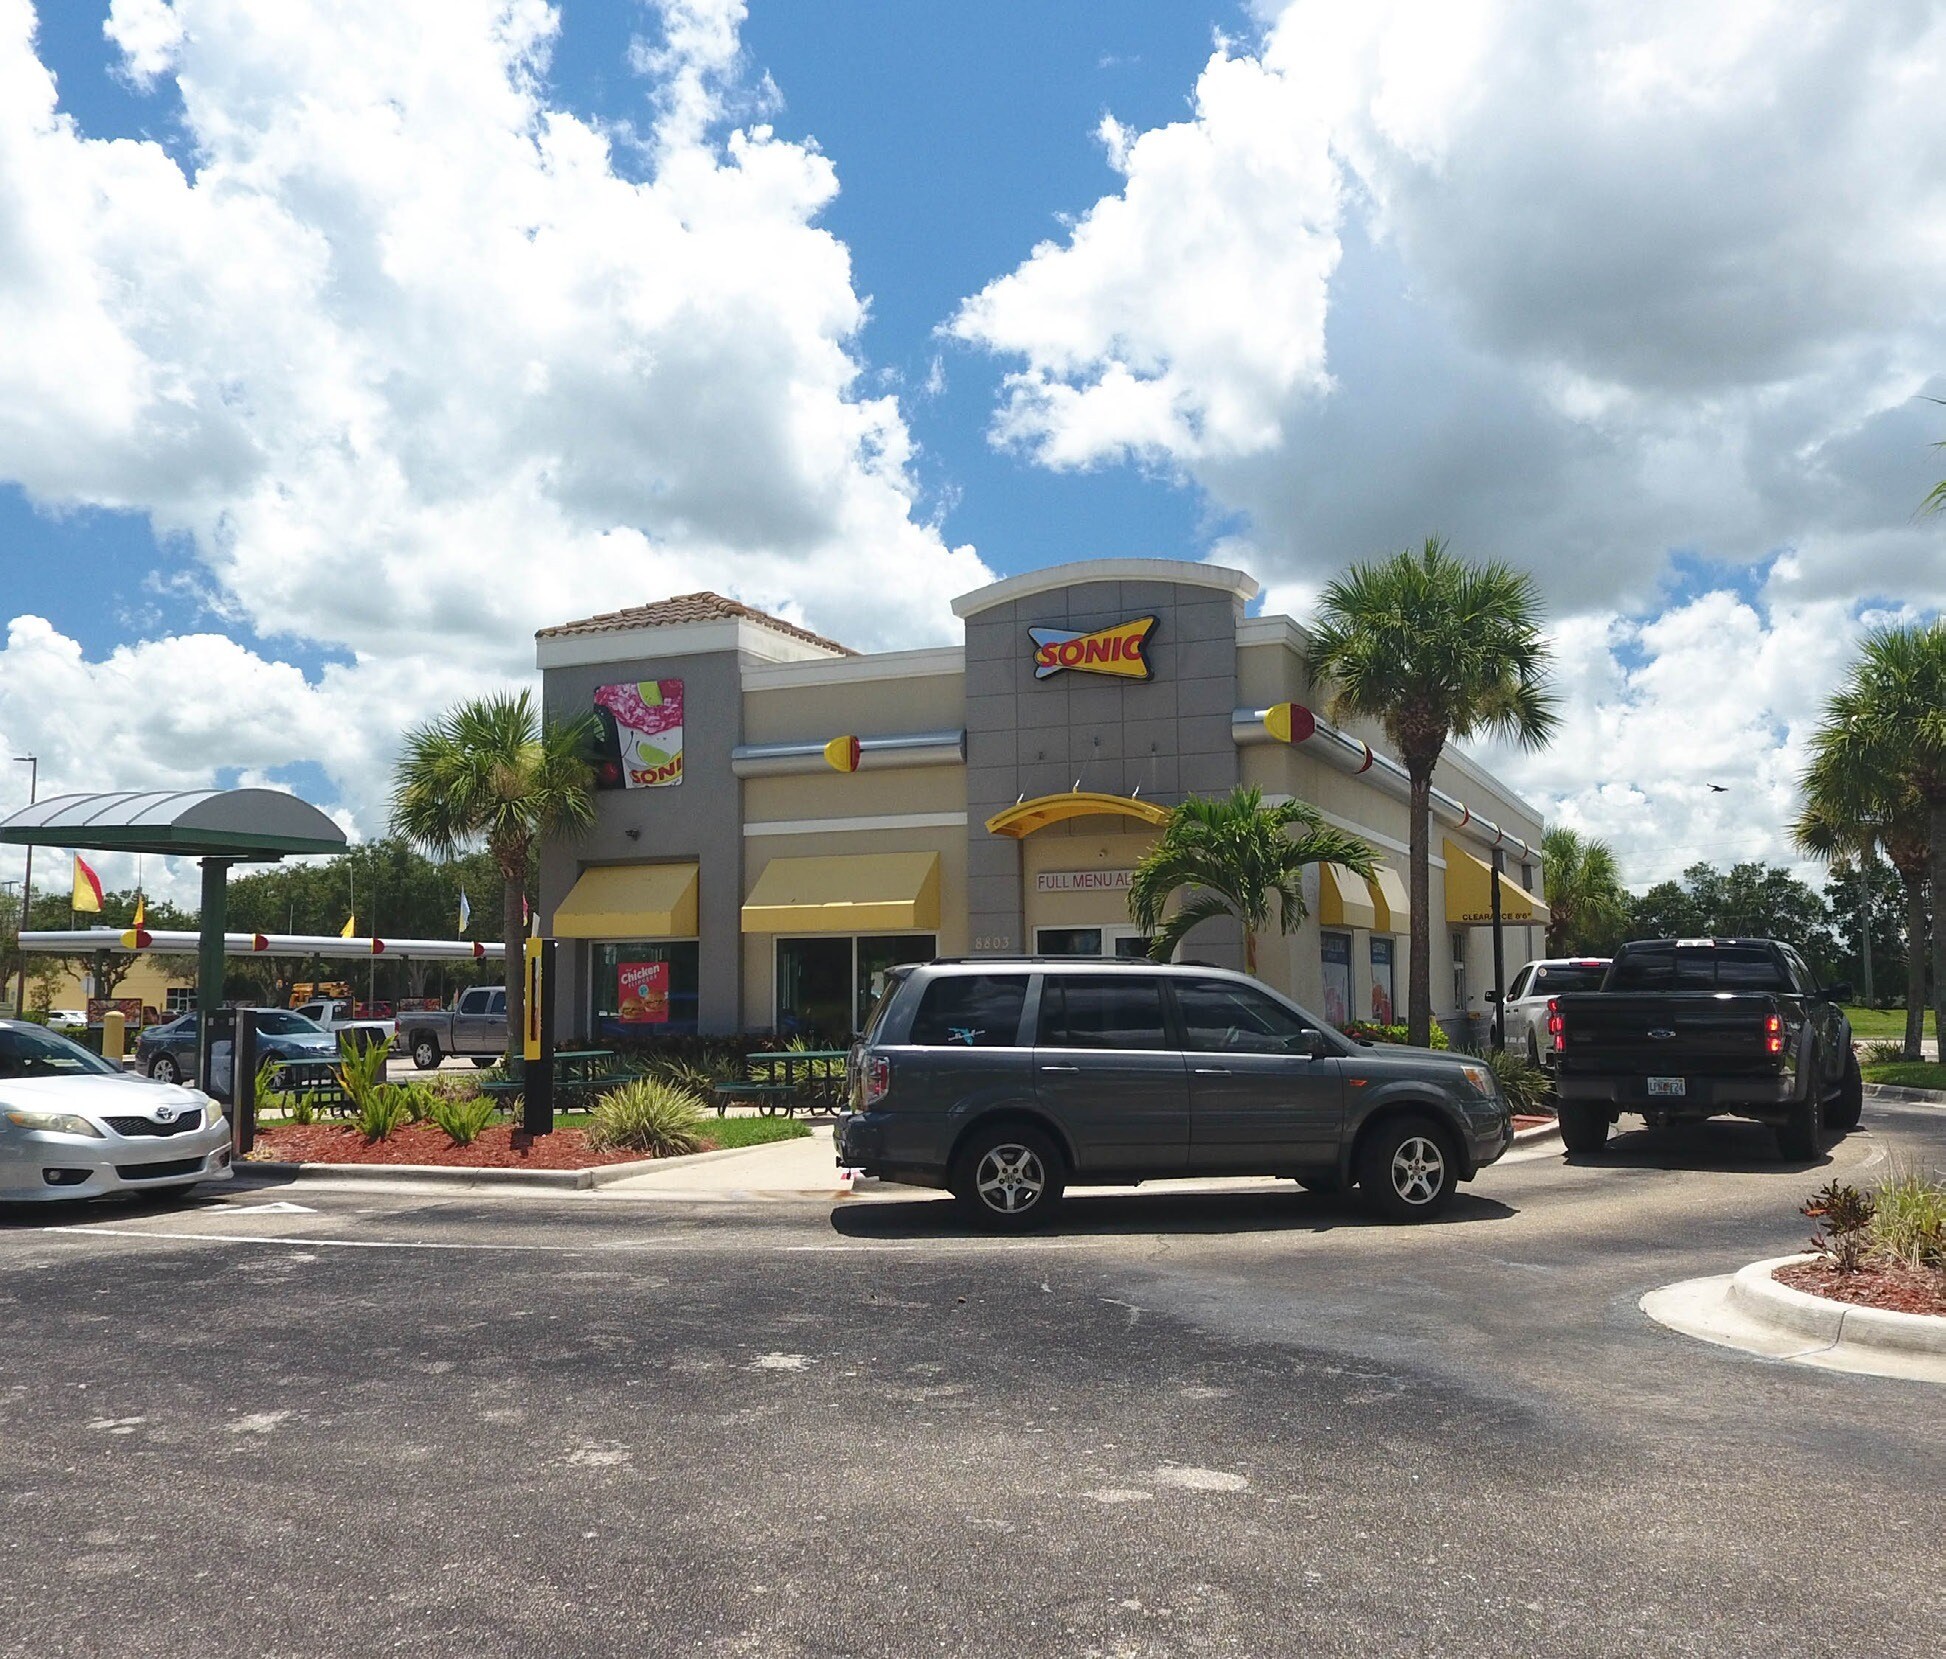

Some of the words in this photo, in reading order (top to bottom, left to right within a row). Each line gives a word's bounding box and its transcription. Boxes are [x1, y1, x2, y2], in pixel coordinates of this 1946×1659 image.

[1041, 634, 1143, 668] SONIC
[1038, 875, 1069, 889] FULL
[1073, 873, 1112, 888] MENU
[1115, 873, 1132, 886] AL
[1462, 912, 1513, 921] CLEARCE
[975, 936, 1009, 950] 8803
[621, 964, 660, 985] Chicken
